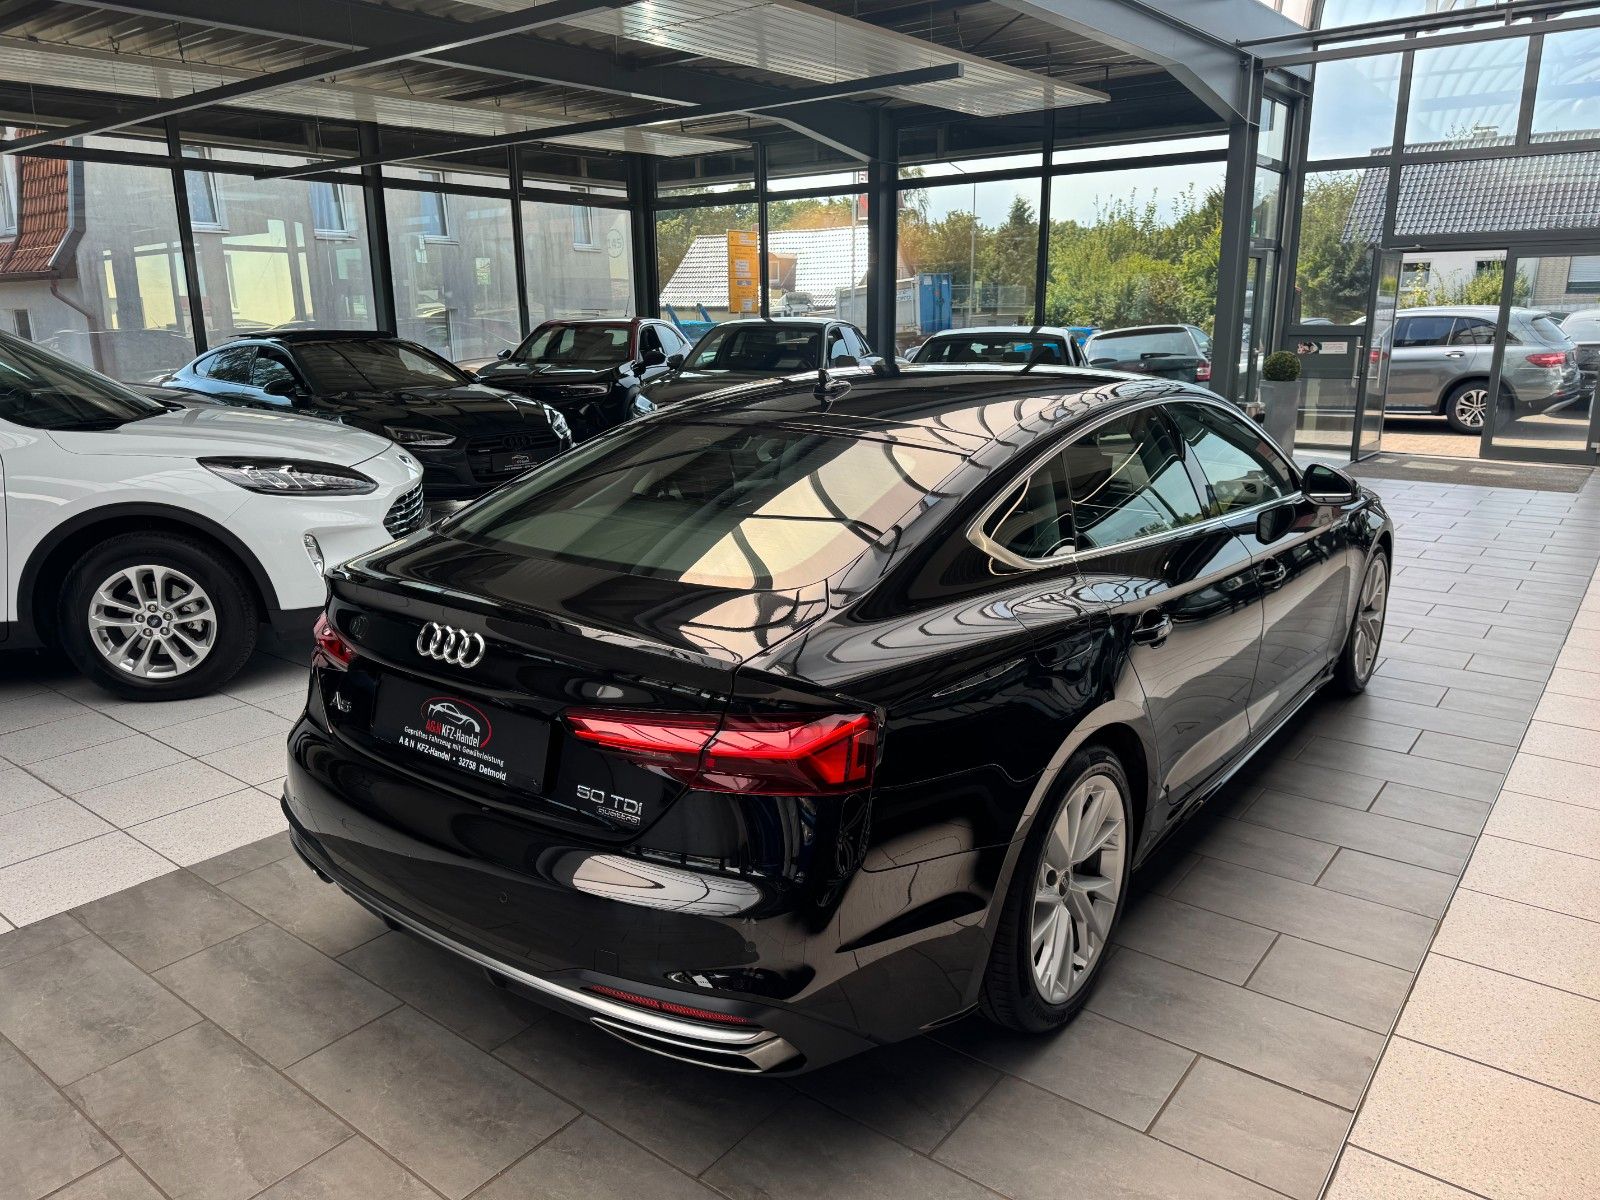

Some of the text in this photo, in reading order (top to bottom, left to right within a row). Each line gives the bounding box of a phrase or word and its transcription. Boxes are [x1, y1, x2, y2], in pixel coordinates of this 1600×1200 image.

[329, 691, 352, 713] A5
[404, 725, 429, 741] Geprüftes
[428, 734, 452, 750] Fahrzeug
[452, 743, 461, 752] mit
[441, 723, 480, 748] KFZ-Handel
[416, 741, 451, 762] KFZ-Handel
[458, 756, 477, 771] 32758
[478, 763, 507, 781] Detmold
[576, 784, 643, 816] 50 TDI
